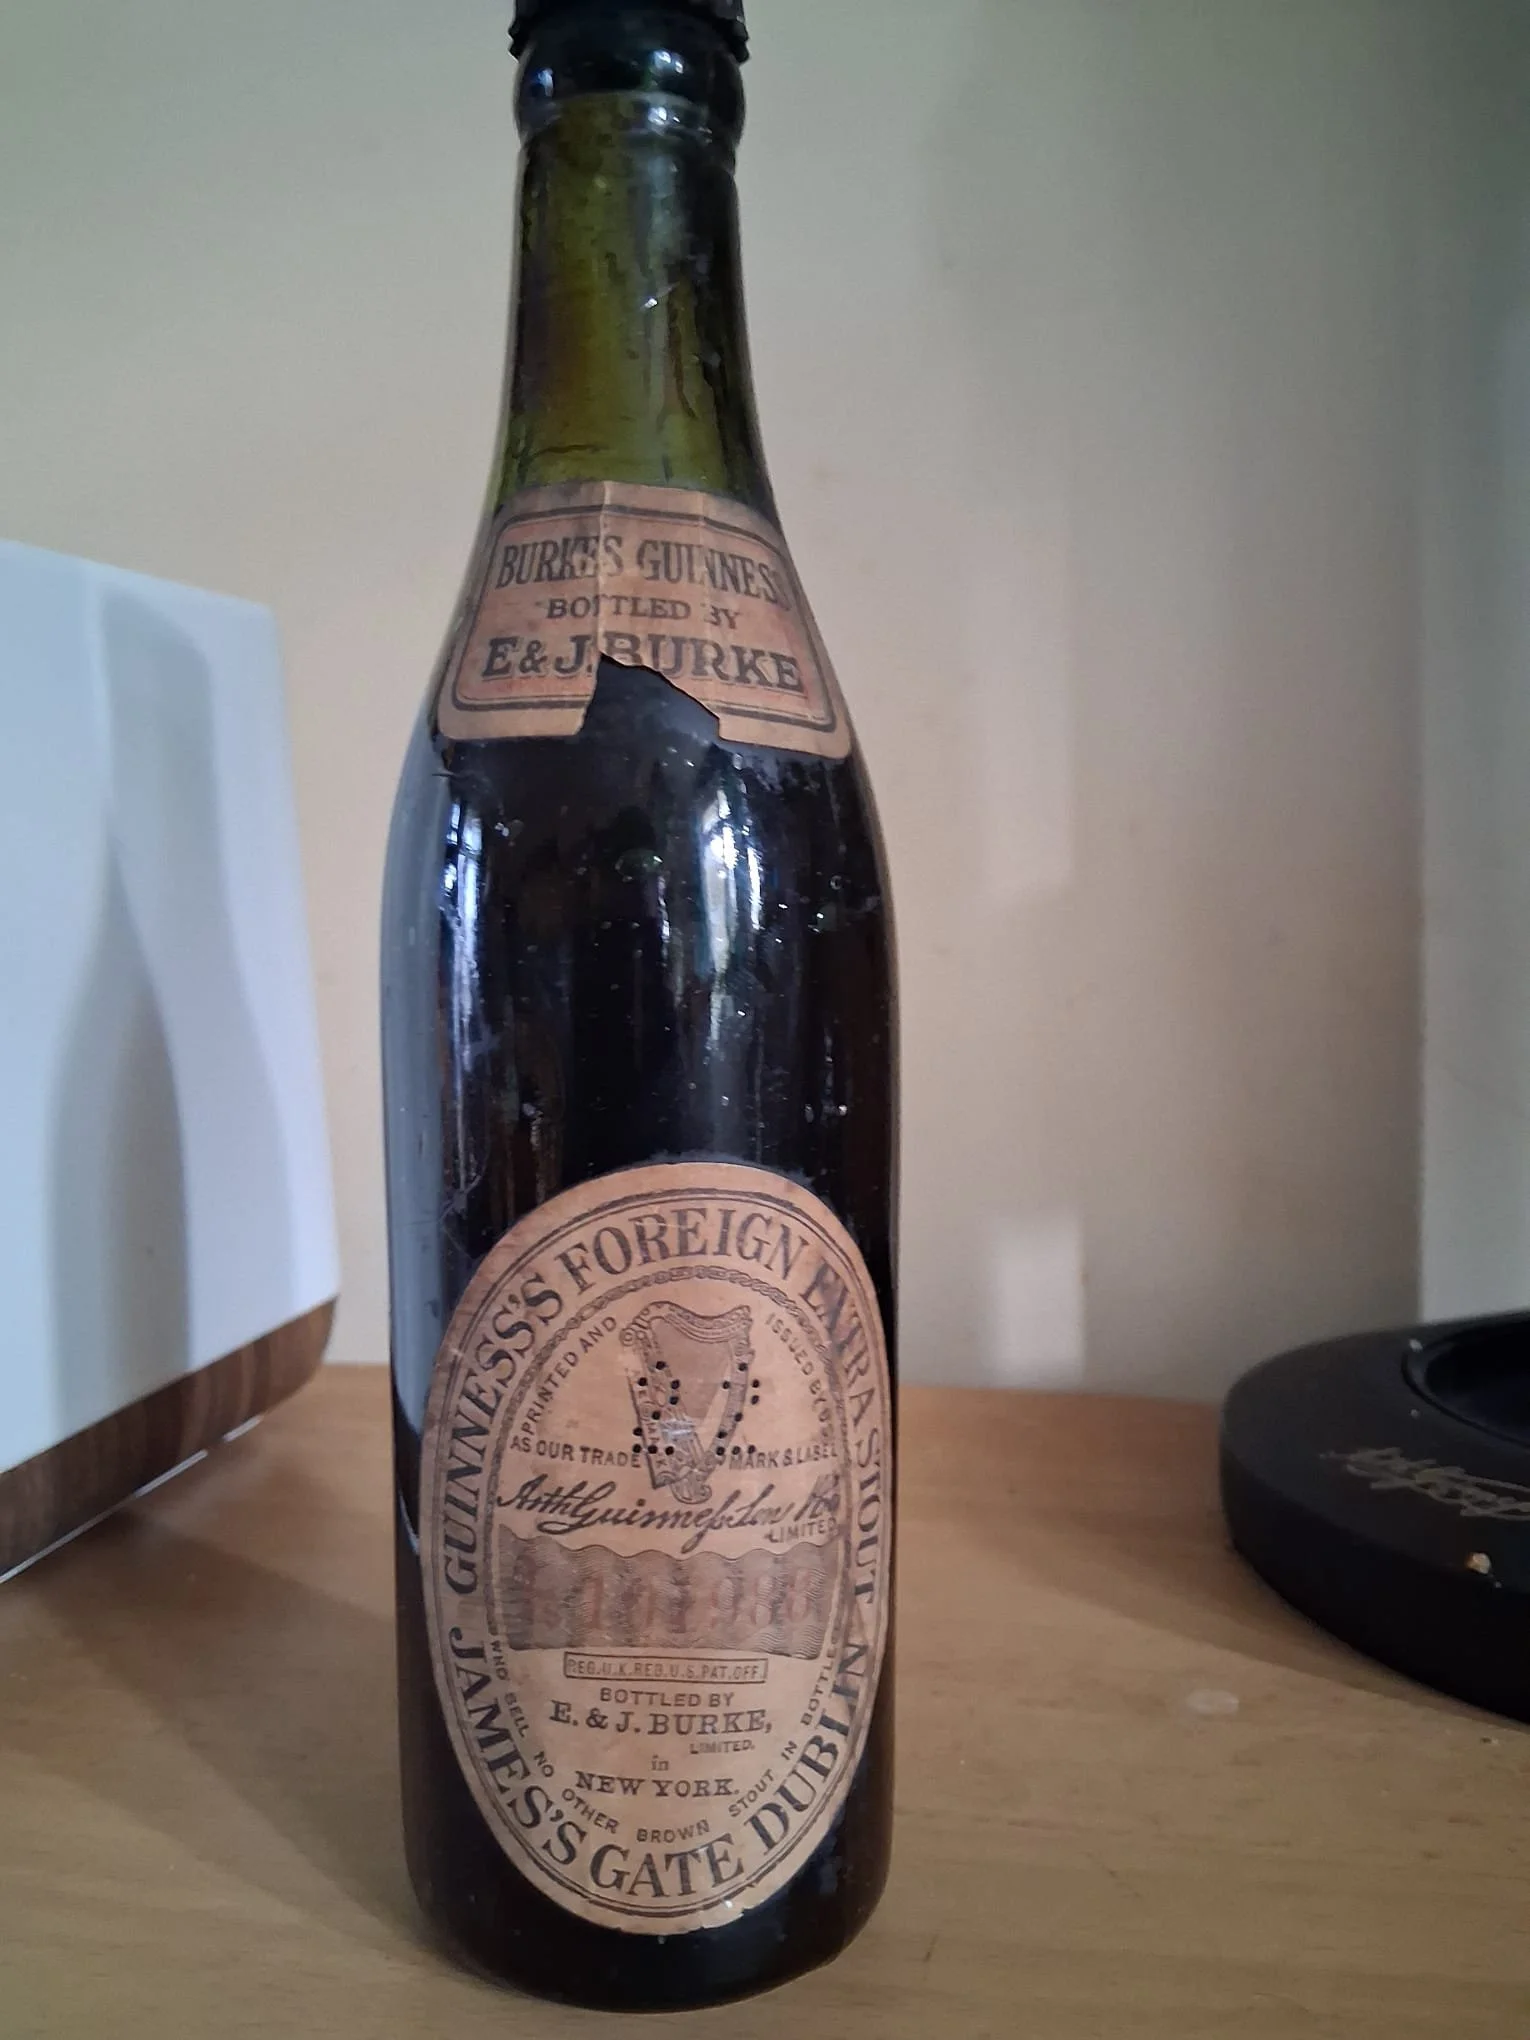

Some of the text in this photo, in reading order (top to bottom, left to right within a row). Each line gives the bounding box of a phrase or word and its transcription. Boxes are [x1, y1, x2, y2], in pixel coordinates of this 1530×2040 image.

[546, 594, 692, 620] BOTTLED
[603, 631, 807, 693] BURKE
[520, 1316, 617, 1436] PRINTED AND
[443, 1272, 563, 1595] GUINNESS'S
[554, 1206, 811, 1294] FOREIGN
[510, 1435, 642, 1469] AS OUR TRADE
[728, 1449, 779, 1470] MARK
[600, 1687, 735, 1708] BOTTLED BY
[550, 1699, 773, 1736] E. & J. BURKE,
[448, 1626, 870, 1898] JAMES'S GATE DUBLIN
[504, 1692, 530, 1739] SELL
[533, 1751, 555, 1778] NO
[561, 1788, 620, 1835] OTHER
[636, 1818, 711, 1844] BROWN
[728, 1768, 775, 1818] STOUT
[780, 1740, 798, 1761] IN
[650, 1754, 670, 1772] in
[575, 1770, 740, 1798] NEW YORK.
